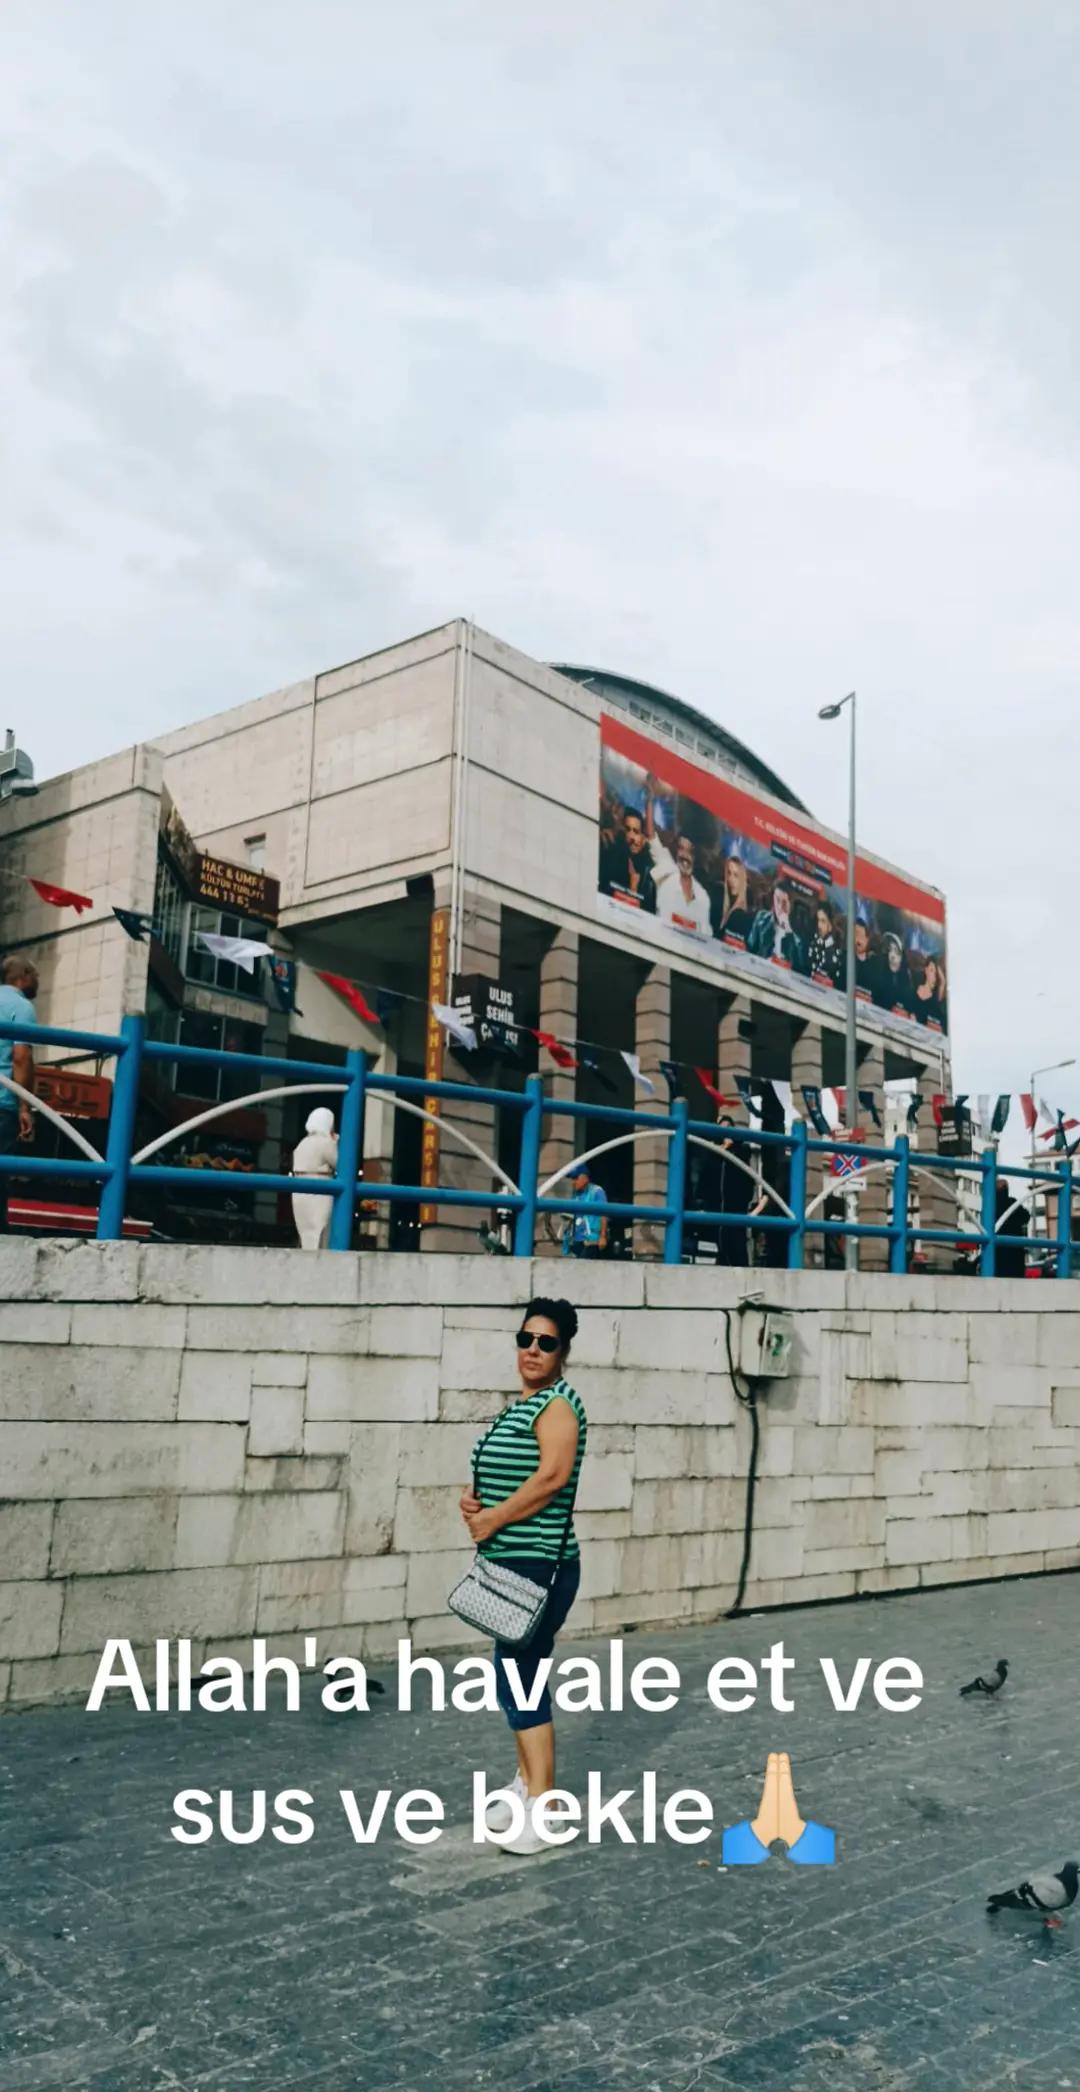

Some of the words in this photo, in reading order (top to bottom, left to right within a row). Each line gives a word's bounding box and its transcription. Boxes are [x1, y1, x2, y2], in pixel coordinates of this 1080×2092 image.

[200, 883, 220, 899] 444
[431, 918, 444, 987] ULUS
[489, 986, 513, 1007] ULUS
